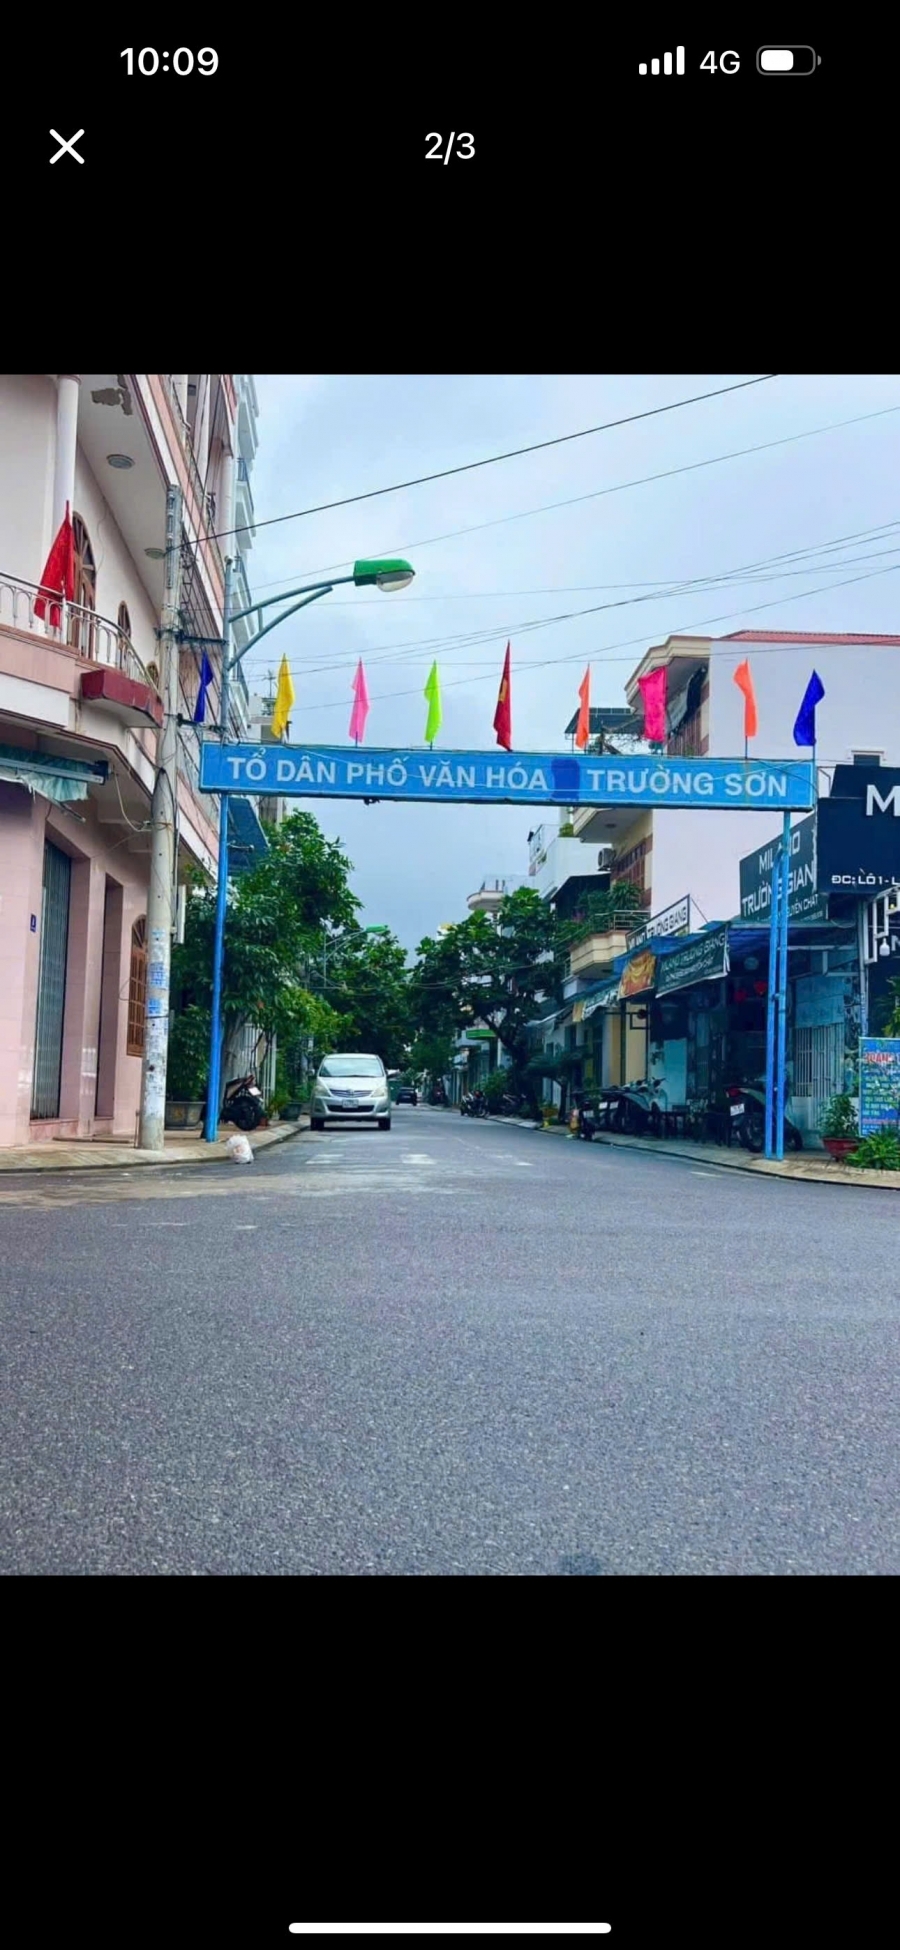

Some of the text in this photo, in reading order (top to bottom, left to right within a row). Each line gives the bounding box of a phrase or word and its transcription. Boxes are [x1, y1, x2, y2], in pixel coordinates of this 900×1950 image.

[227, 748, 787, 797] TỔ DÂN PHỐ VĂN HÓA TRƯỜNG SƠN
[831, 875, 856, 885] ĐC:
